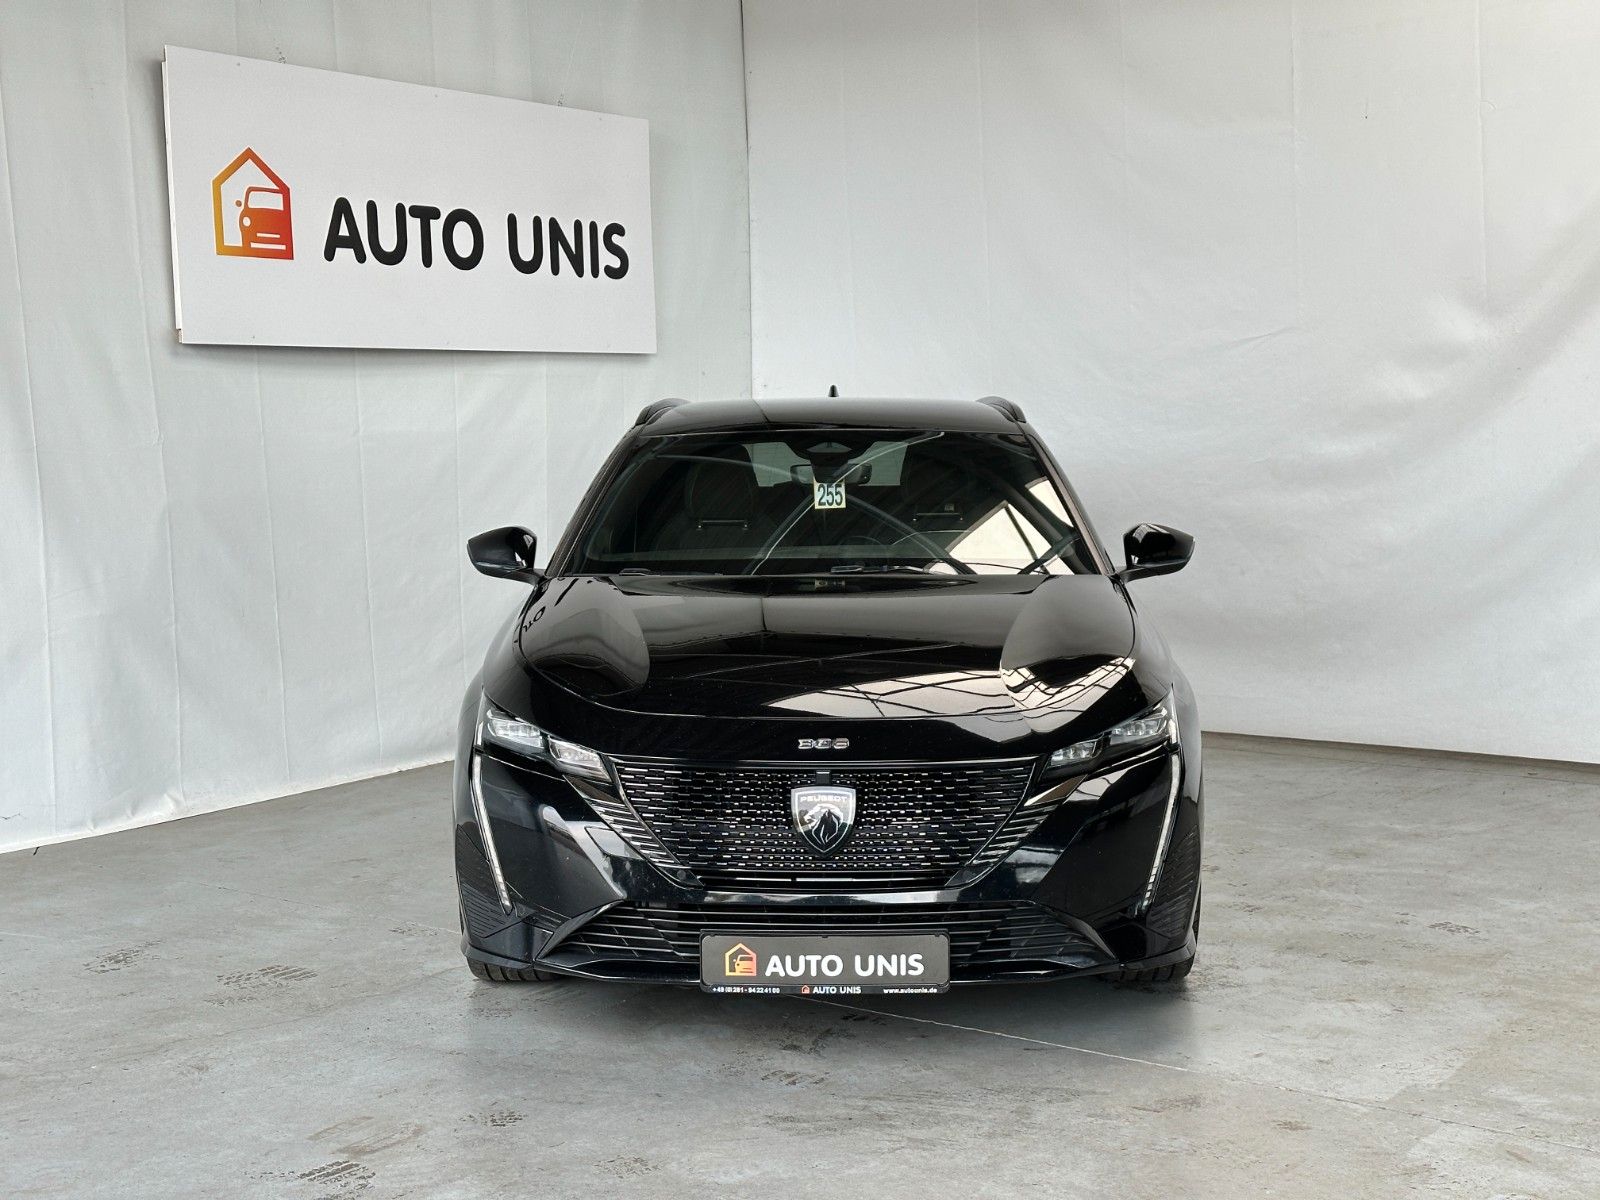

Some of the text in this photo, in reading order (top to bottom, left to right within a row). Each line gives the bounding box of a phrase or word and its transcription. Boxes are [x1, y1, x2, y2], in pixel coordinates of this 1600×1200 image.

[323, 196, 630, 280] AUTO UNIS
[817, 483, 843, 506] 255
[765, 953, 925, 977] AUTO UNIS
[812, 986, 862, 995] AUTO UNIS
